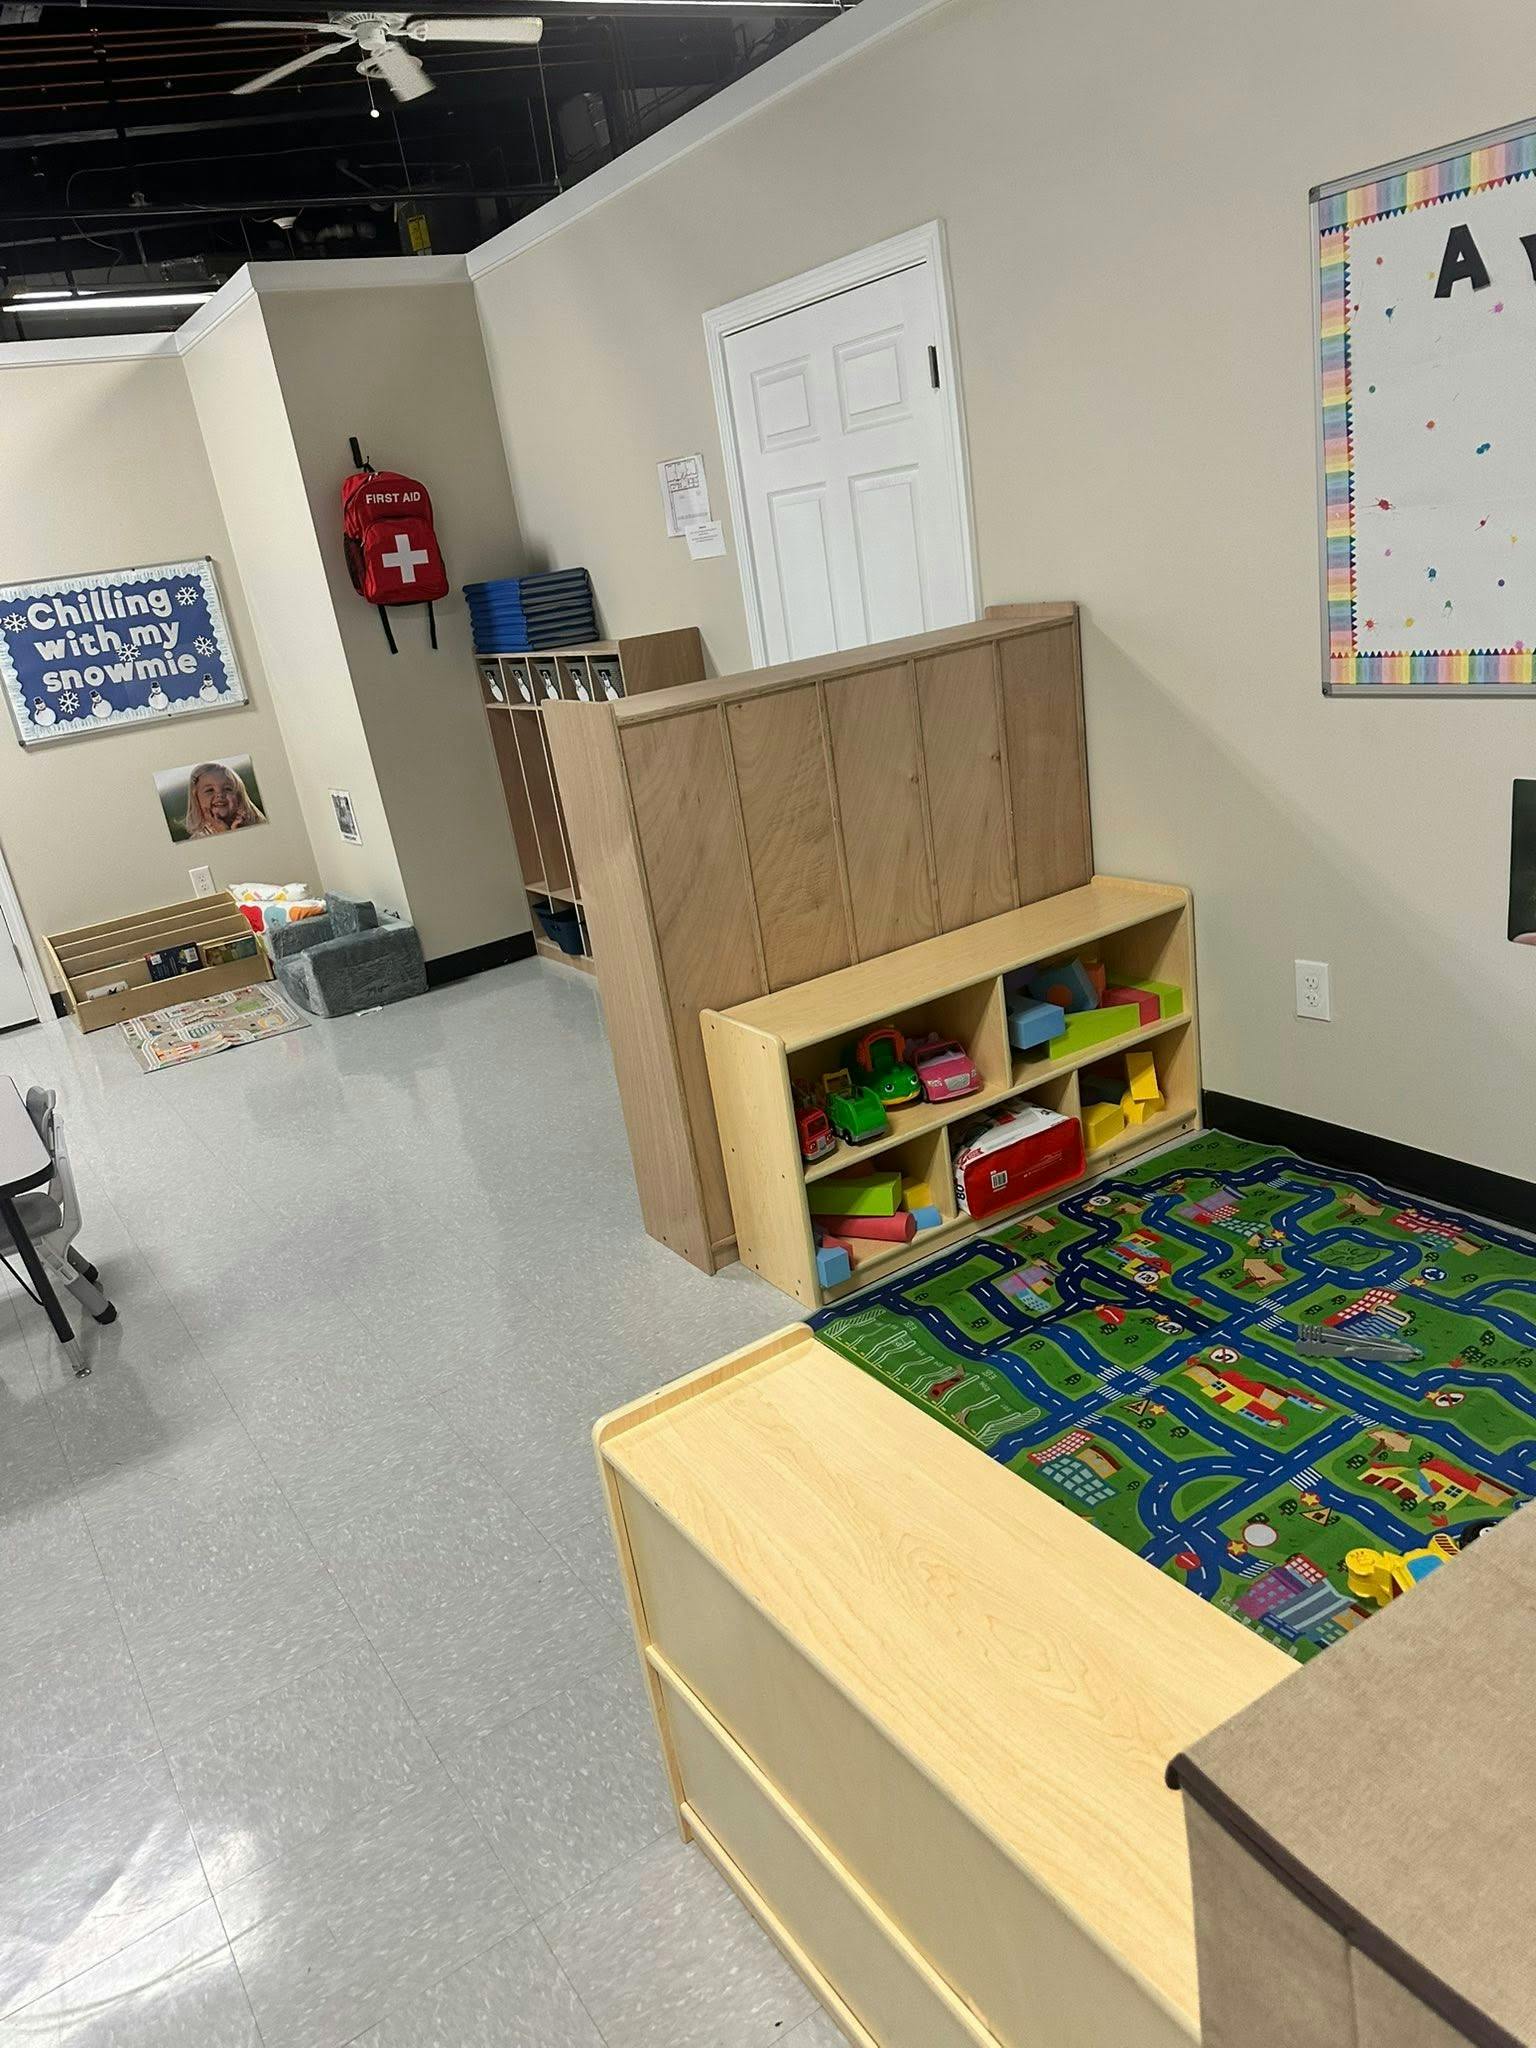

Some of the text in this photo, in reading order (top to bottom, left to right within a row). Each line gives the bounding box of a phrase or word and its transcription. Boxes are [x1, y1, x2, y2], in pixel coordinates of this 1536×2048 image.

[366, 491, 421, 504] FIRST AID
[27, 588, 173, 631] Chilling
[34, 621, 181, 661] with my
[43, 650, 198, 693] snowmie
